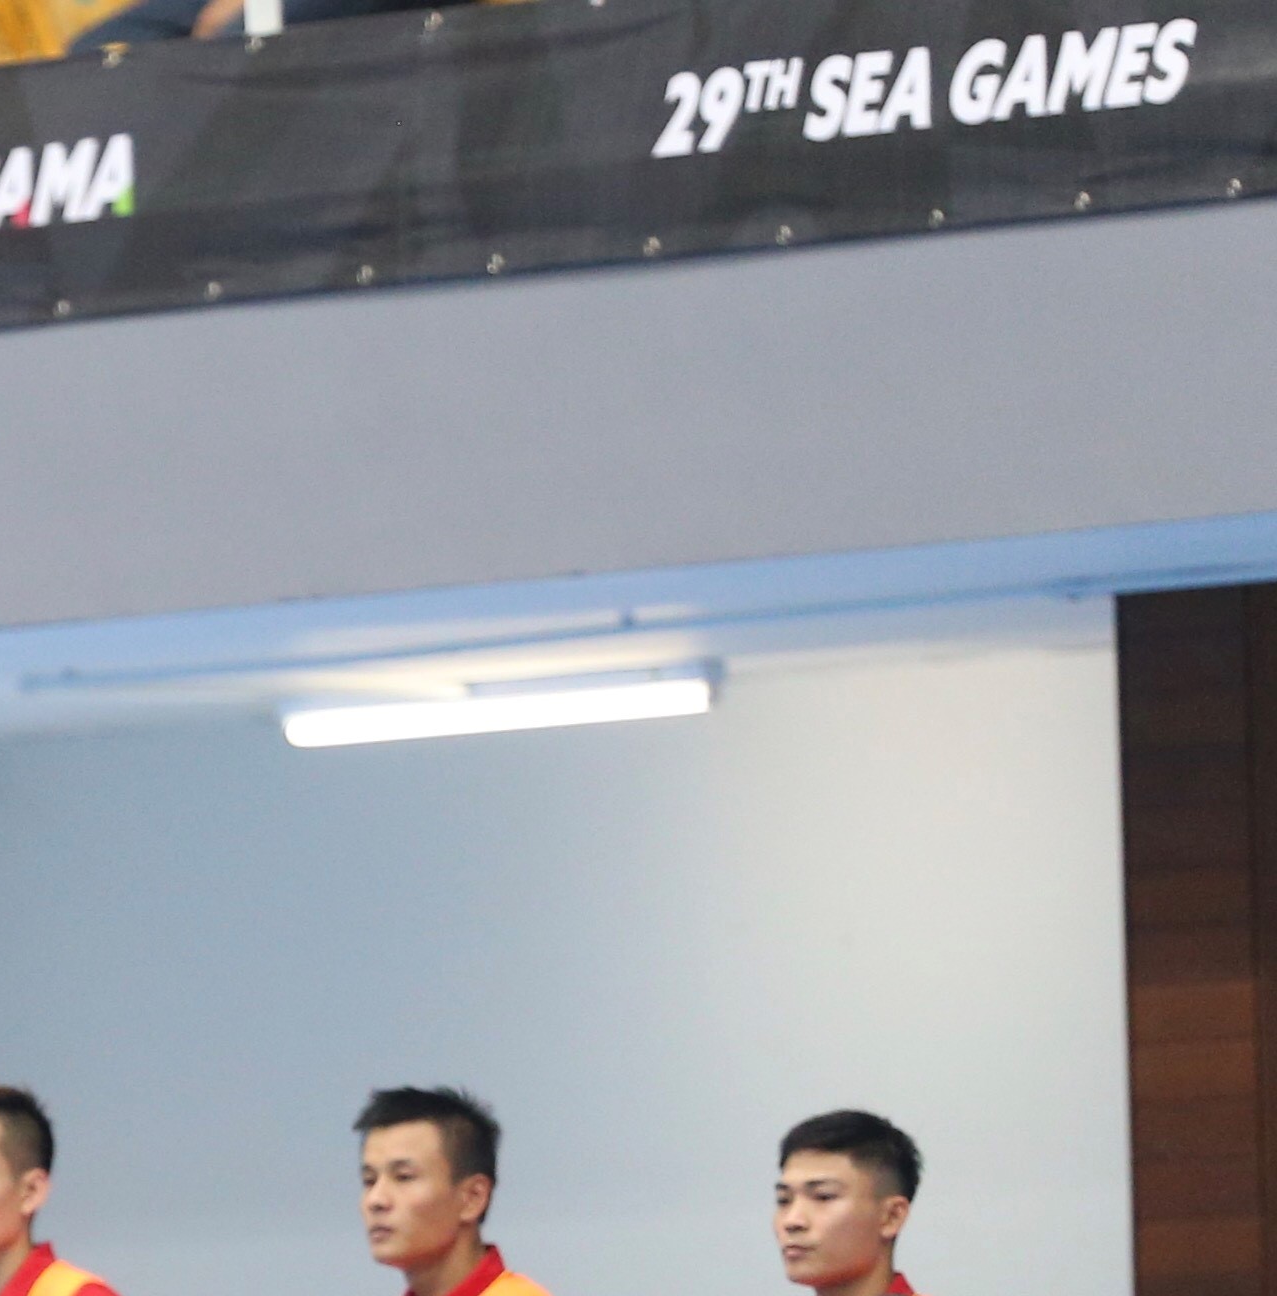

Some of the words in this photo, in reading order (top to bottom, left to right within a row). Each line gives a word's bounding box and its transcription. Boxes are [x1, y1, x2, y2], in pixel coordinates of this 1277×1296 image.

[650, 56, 804, 159] 29TH
[801, 46, 933, 142] SEA
[948, 17, 1199, 126] GAMES
